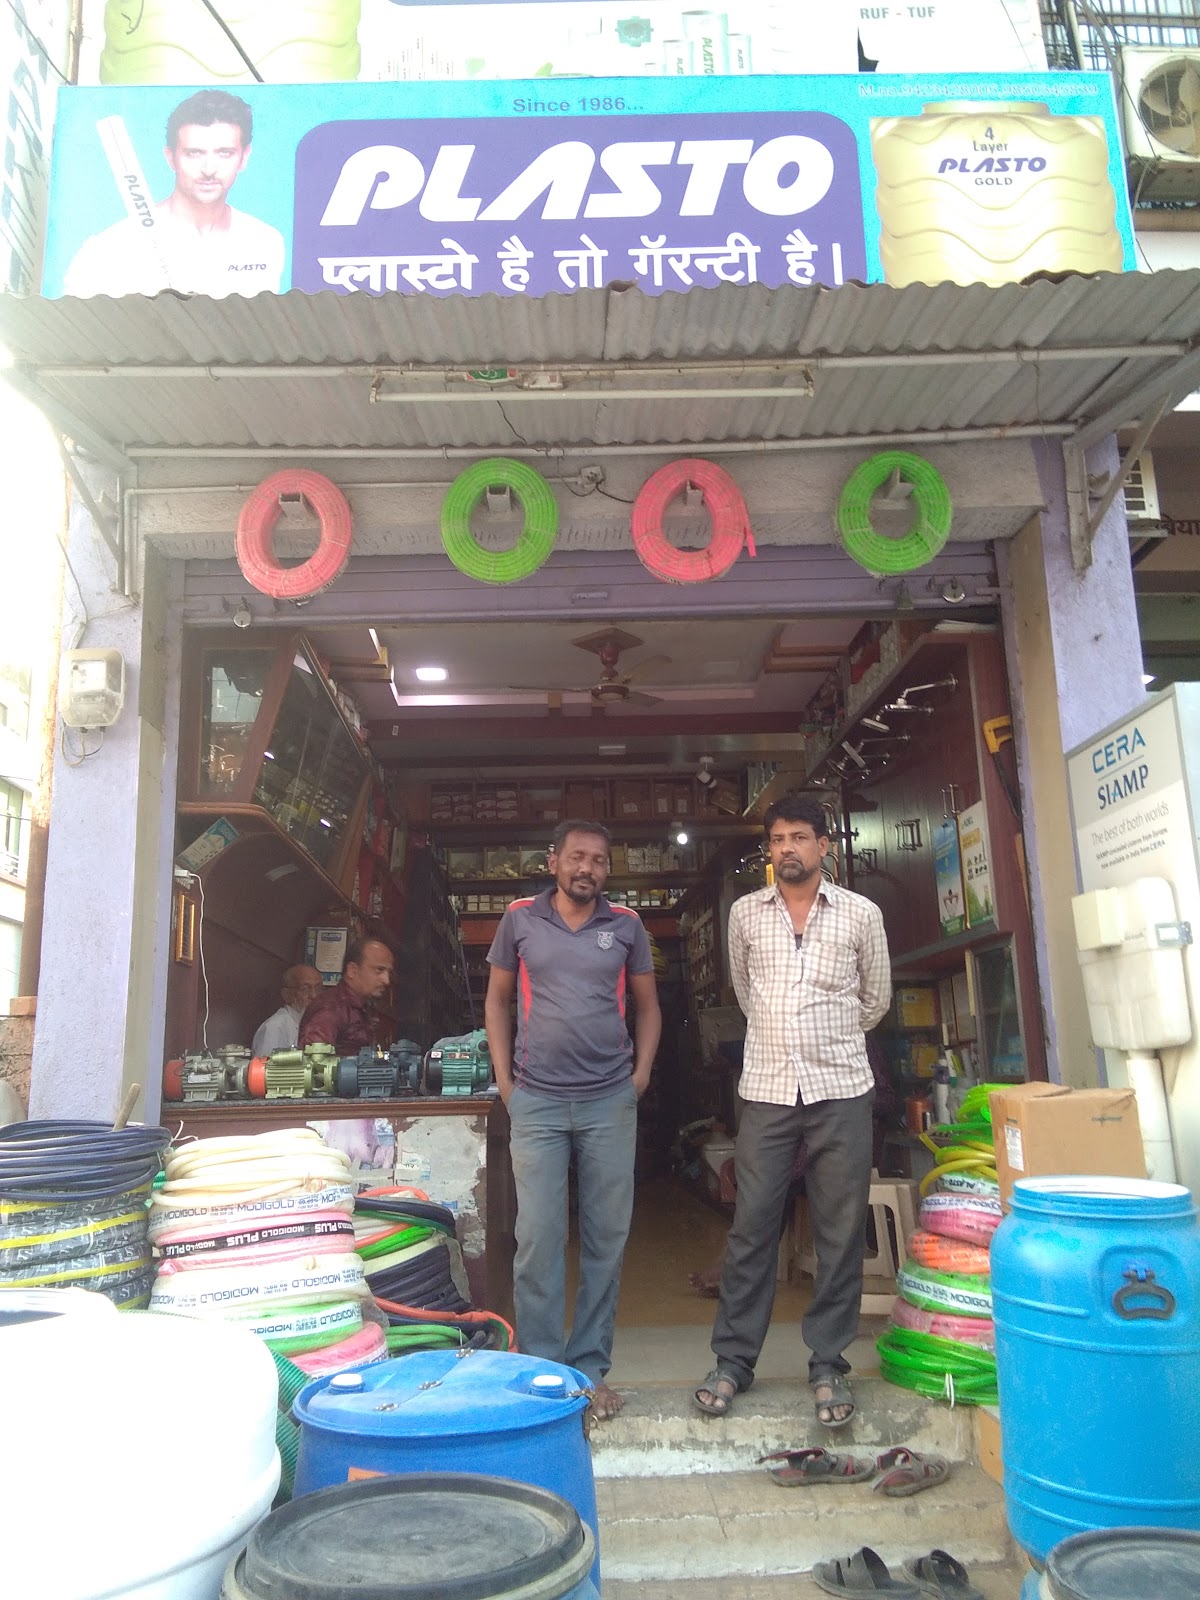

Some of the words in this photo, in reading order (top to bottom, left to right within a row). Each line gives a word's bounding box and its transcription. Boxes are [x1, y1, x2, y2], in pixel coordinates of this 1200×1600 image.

[860, 7, 889, 19] RUF
[907, 6, 936, 18] TUF
[702, 37, 714, 74] PLASTO
[513, 98, 571, 112] Since
[984, 127, 995, 140] 4
[973, 140, 1008, 154] Layer
[937, 157, 1047, 173] PLASTO
[320, 135, 834, 226] PLASTO
[974, 177, 1013, 186] GOLD
[124, 174, 155, 228] PLASTO
[228, 263, 267, 272] PLASTO
[317, 238, 479, 292] प्लास्टो
[497, 234, 535, 292] है
[553, 233, 608, 289] तो
[1091, 727, 1147, 774] CERA
[1097, 763, 1150, 810] SIAMP
[1104, 825, 1118, 841] best
[1126, 812, 1144, 832] both
[1144, 800, 1170, 824] worlds
[237, 1199, 295, 1212] MODIGOLD
[164, 1207, 208, 1220] MODIGOLD
[262, 1225, 305, 1238] MODIGOLD
[315, 1222, 338, 1233] PLUS
[226, 1232, 260, 1246] PLUS
[166, 1244, 186, 1256] PLUS
[292, 1273, 341, 1288] MODIGOLD
[200, 1286, 259, 1303] MODIGOLD
[320, 1308, 356, 1325] MODIGOLD
